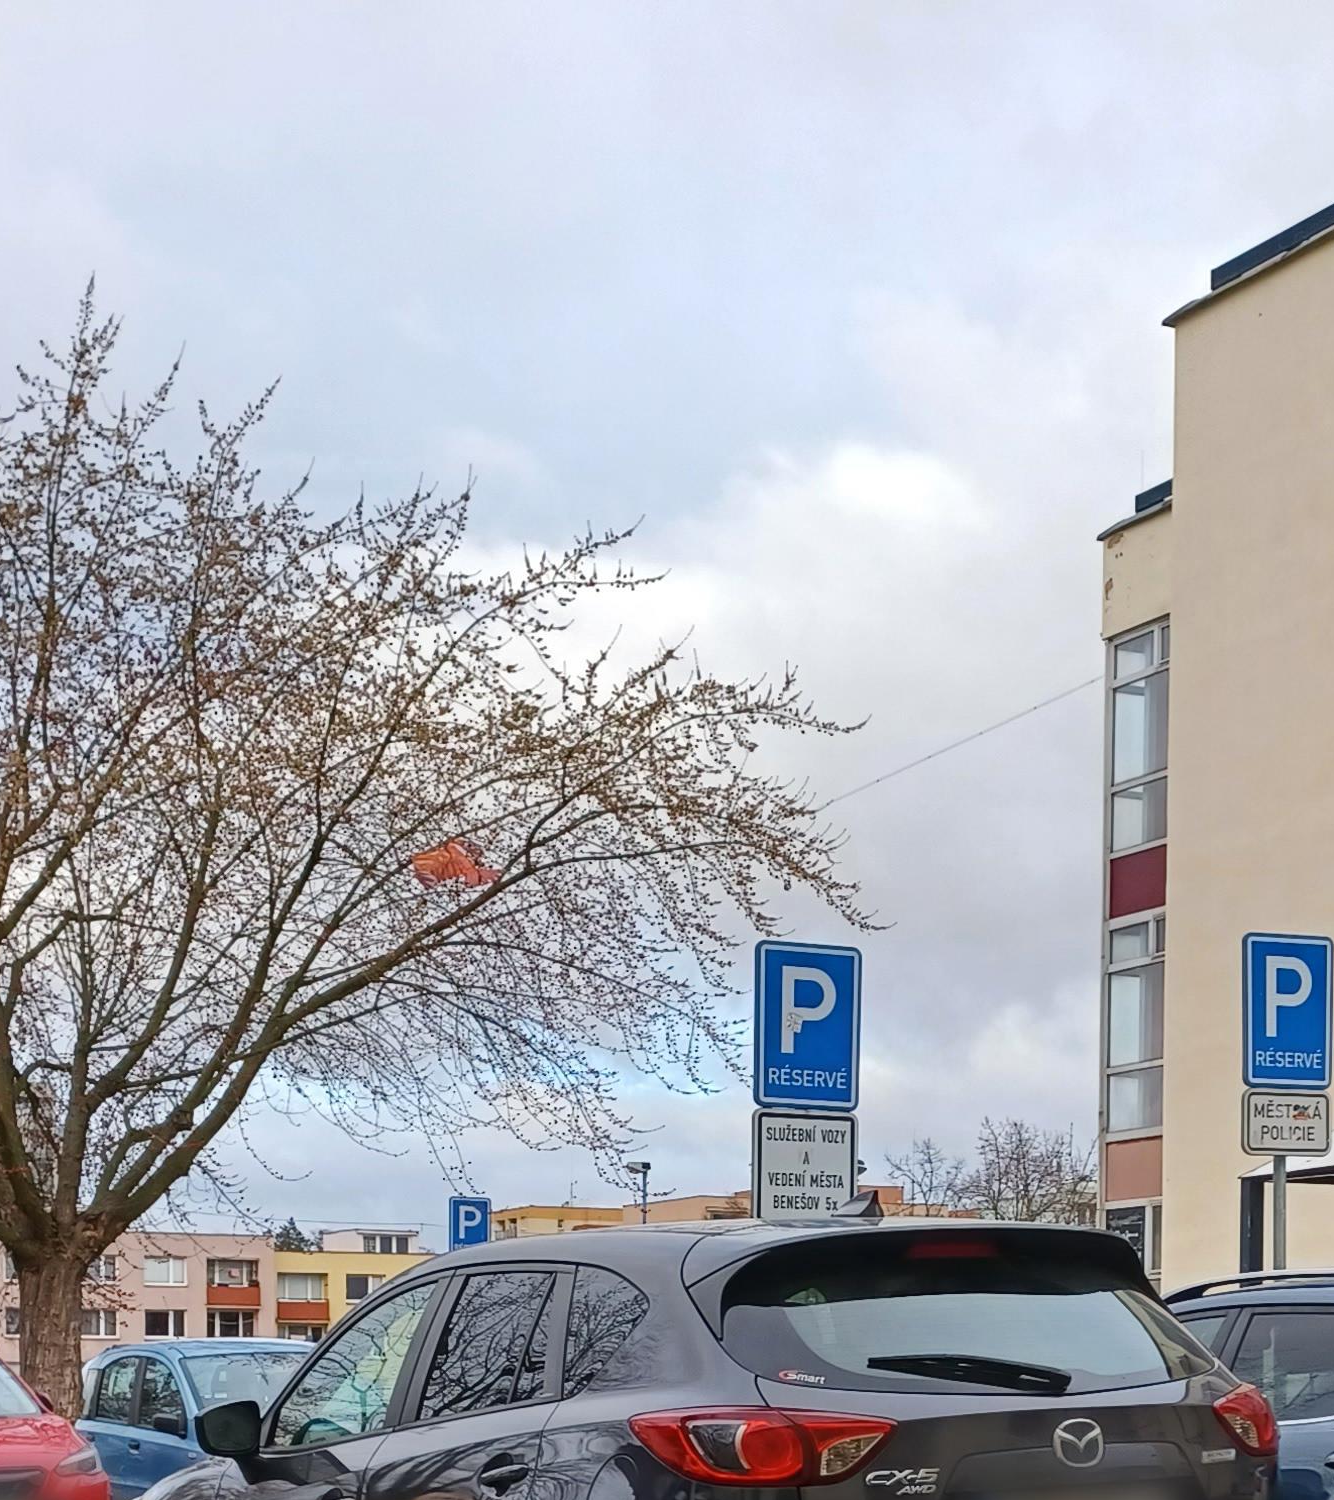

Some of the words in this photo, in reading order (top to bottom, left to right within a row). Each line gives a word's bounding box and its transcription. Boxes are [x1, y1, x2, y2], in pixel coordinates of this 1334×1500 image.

[1266, 955, 1312, 1038] P
[780, 965, 837, 1054] P
[1255, 1048, 1323, 1069] RÉSERVÉ
[768, 1064, 848, 1090] RÉSERVÉ
[1254, 1099, 1322, 1121] MĚSTKÁ
[765, 1123, 817, 1144] SLUŽEBNÍ
[821, 1128, 847, 1145] VOZY
[1261, 1124, 1316, 1142] POLICIE
[802, 1151, 811, 1165] A
[768, 1169, 807, 1188] VEDENÍ
[810, 1170, 845, 1189] MĚSTA
[772, 1191, 821, 1211] BENEŠOV
[825, 1196, 838, 1212] 5x
[458, 1205, 482, 1240] P
[865, 1467, 941, 1487] CX-5
[896, 1485, 937, 1496] AWD
